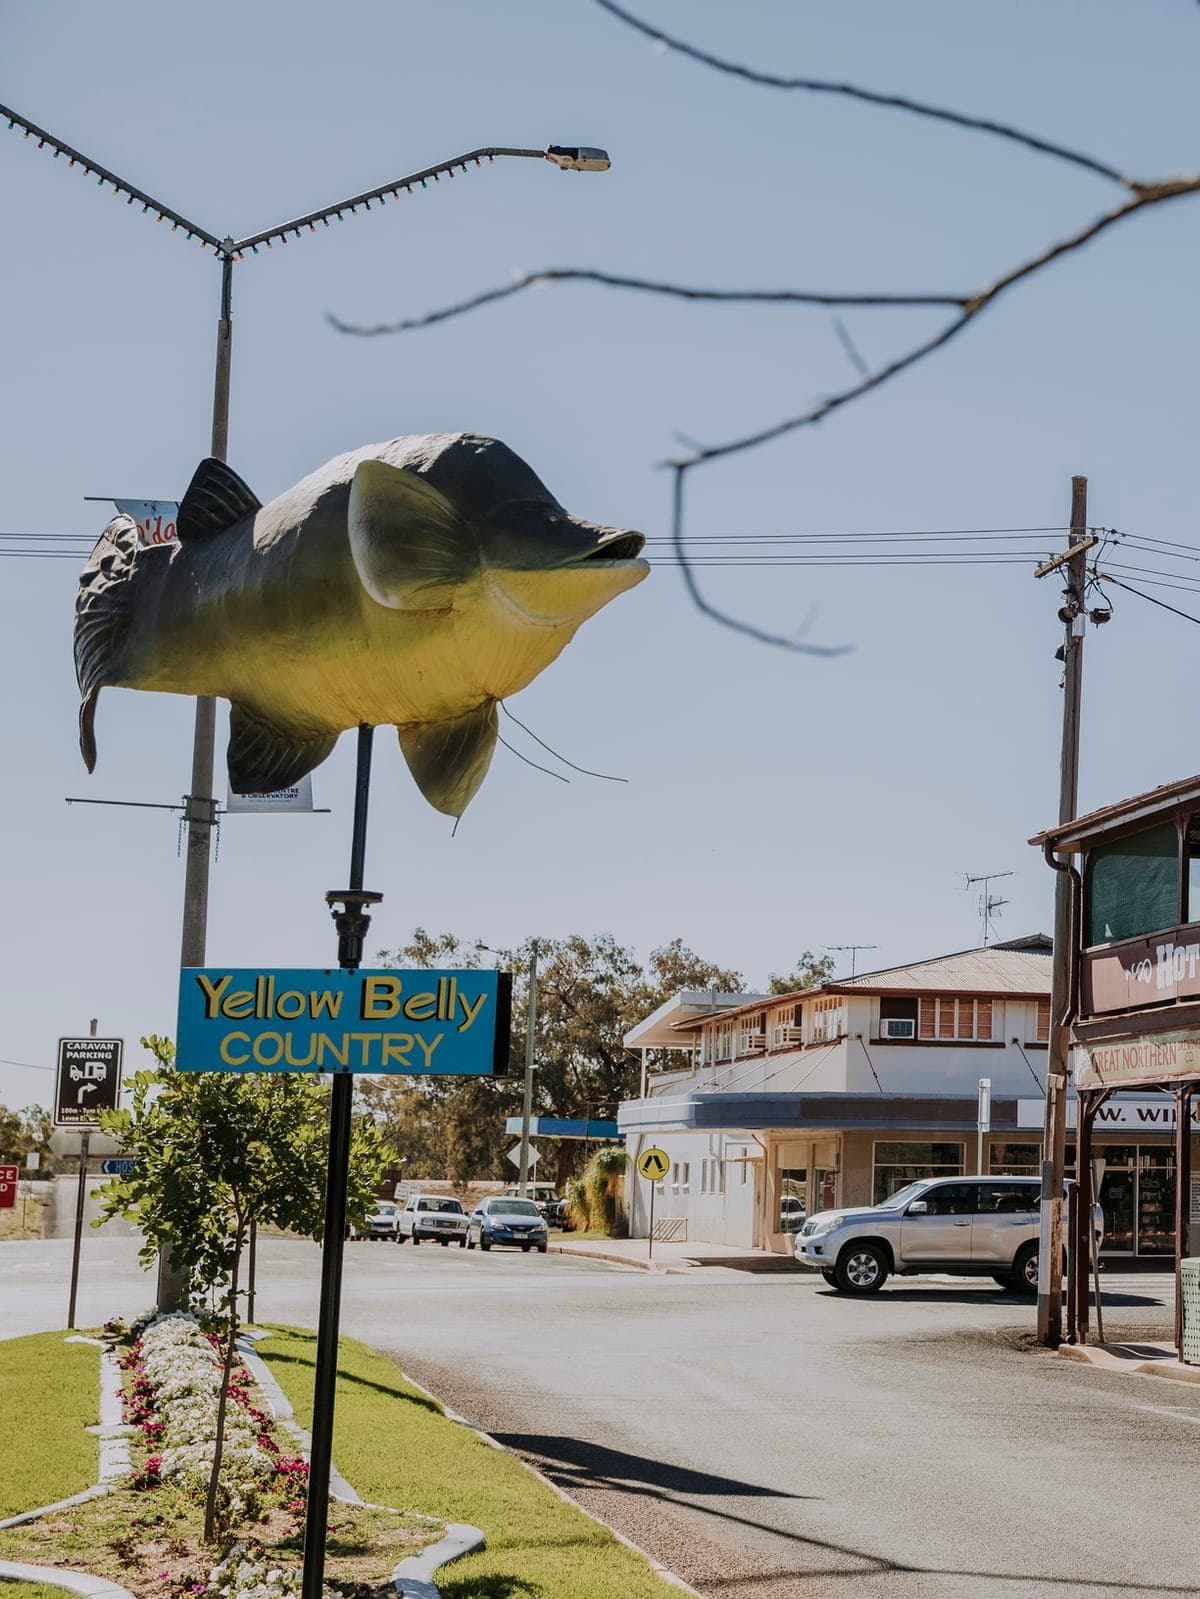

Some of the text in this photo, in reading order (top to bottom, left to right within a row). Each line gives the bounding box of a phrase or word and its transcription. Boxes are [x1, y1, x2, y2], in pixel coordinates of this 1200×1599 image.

[196, 975, 488, 1033] Yellow Belly
[66, 1043, 115, 1051] CARAVAN
[66, 1051, 113, 1060] PARKING
[220, 1031, 444, 1067] COUNTRY
[1122, 1042, 1177, 1070] NORTHERN
